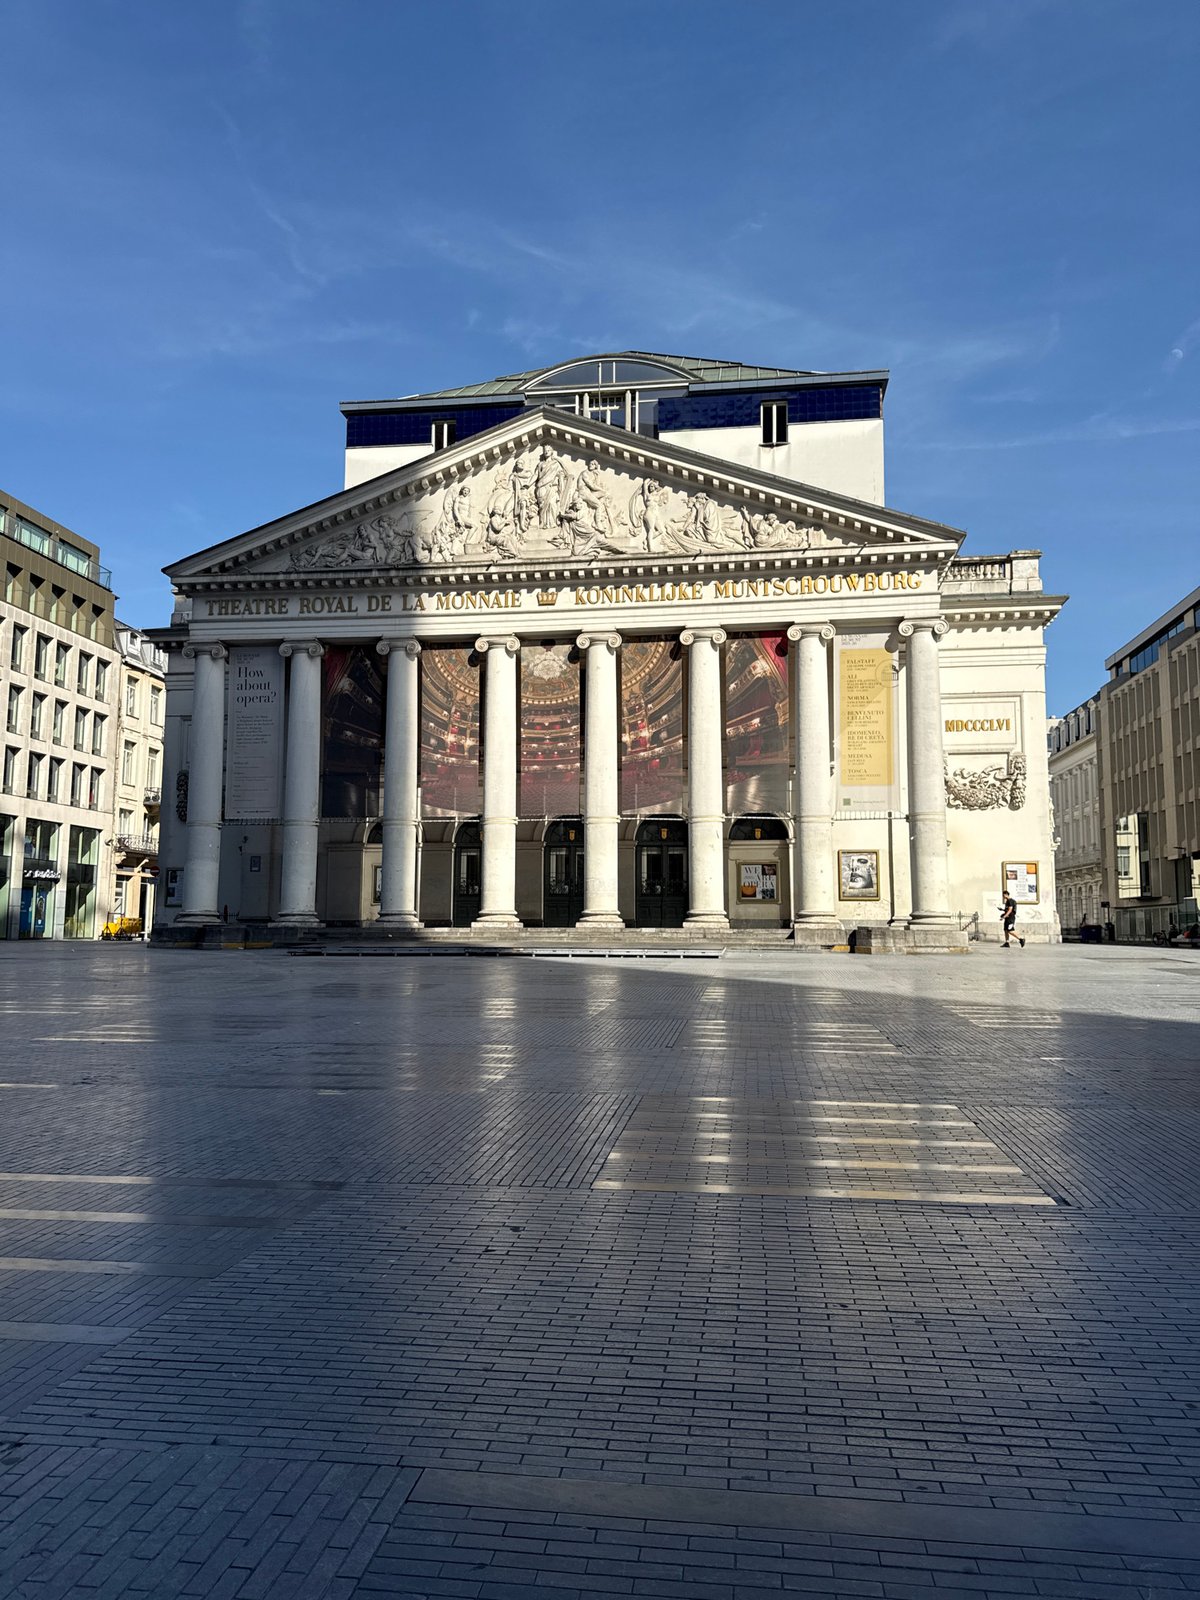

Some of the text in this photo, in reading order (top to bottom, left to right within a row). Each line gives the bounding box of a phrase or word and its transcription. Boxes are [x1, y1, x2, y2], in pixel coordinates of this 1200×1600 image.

[575, 572, 922, 605] KONINKLIJKE MUNTSCHOUWBURG
[205, 591, 522, 616] THEATRE ROYAL DE LA MONNAIE
[238, 666, 263, 678] How
[236, 679, 270, 690] about
[236, 691, 277, 707] opera?
[945, 718, 1010, 732] MDCCCLVI
